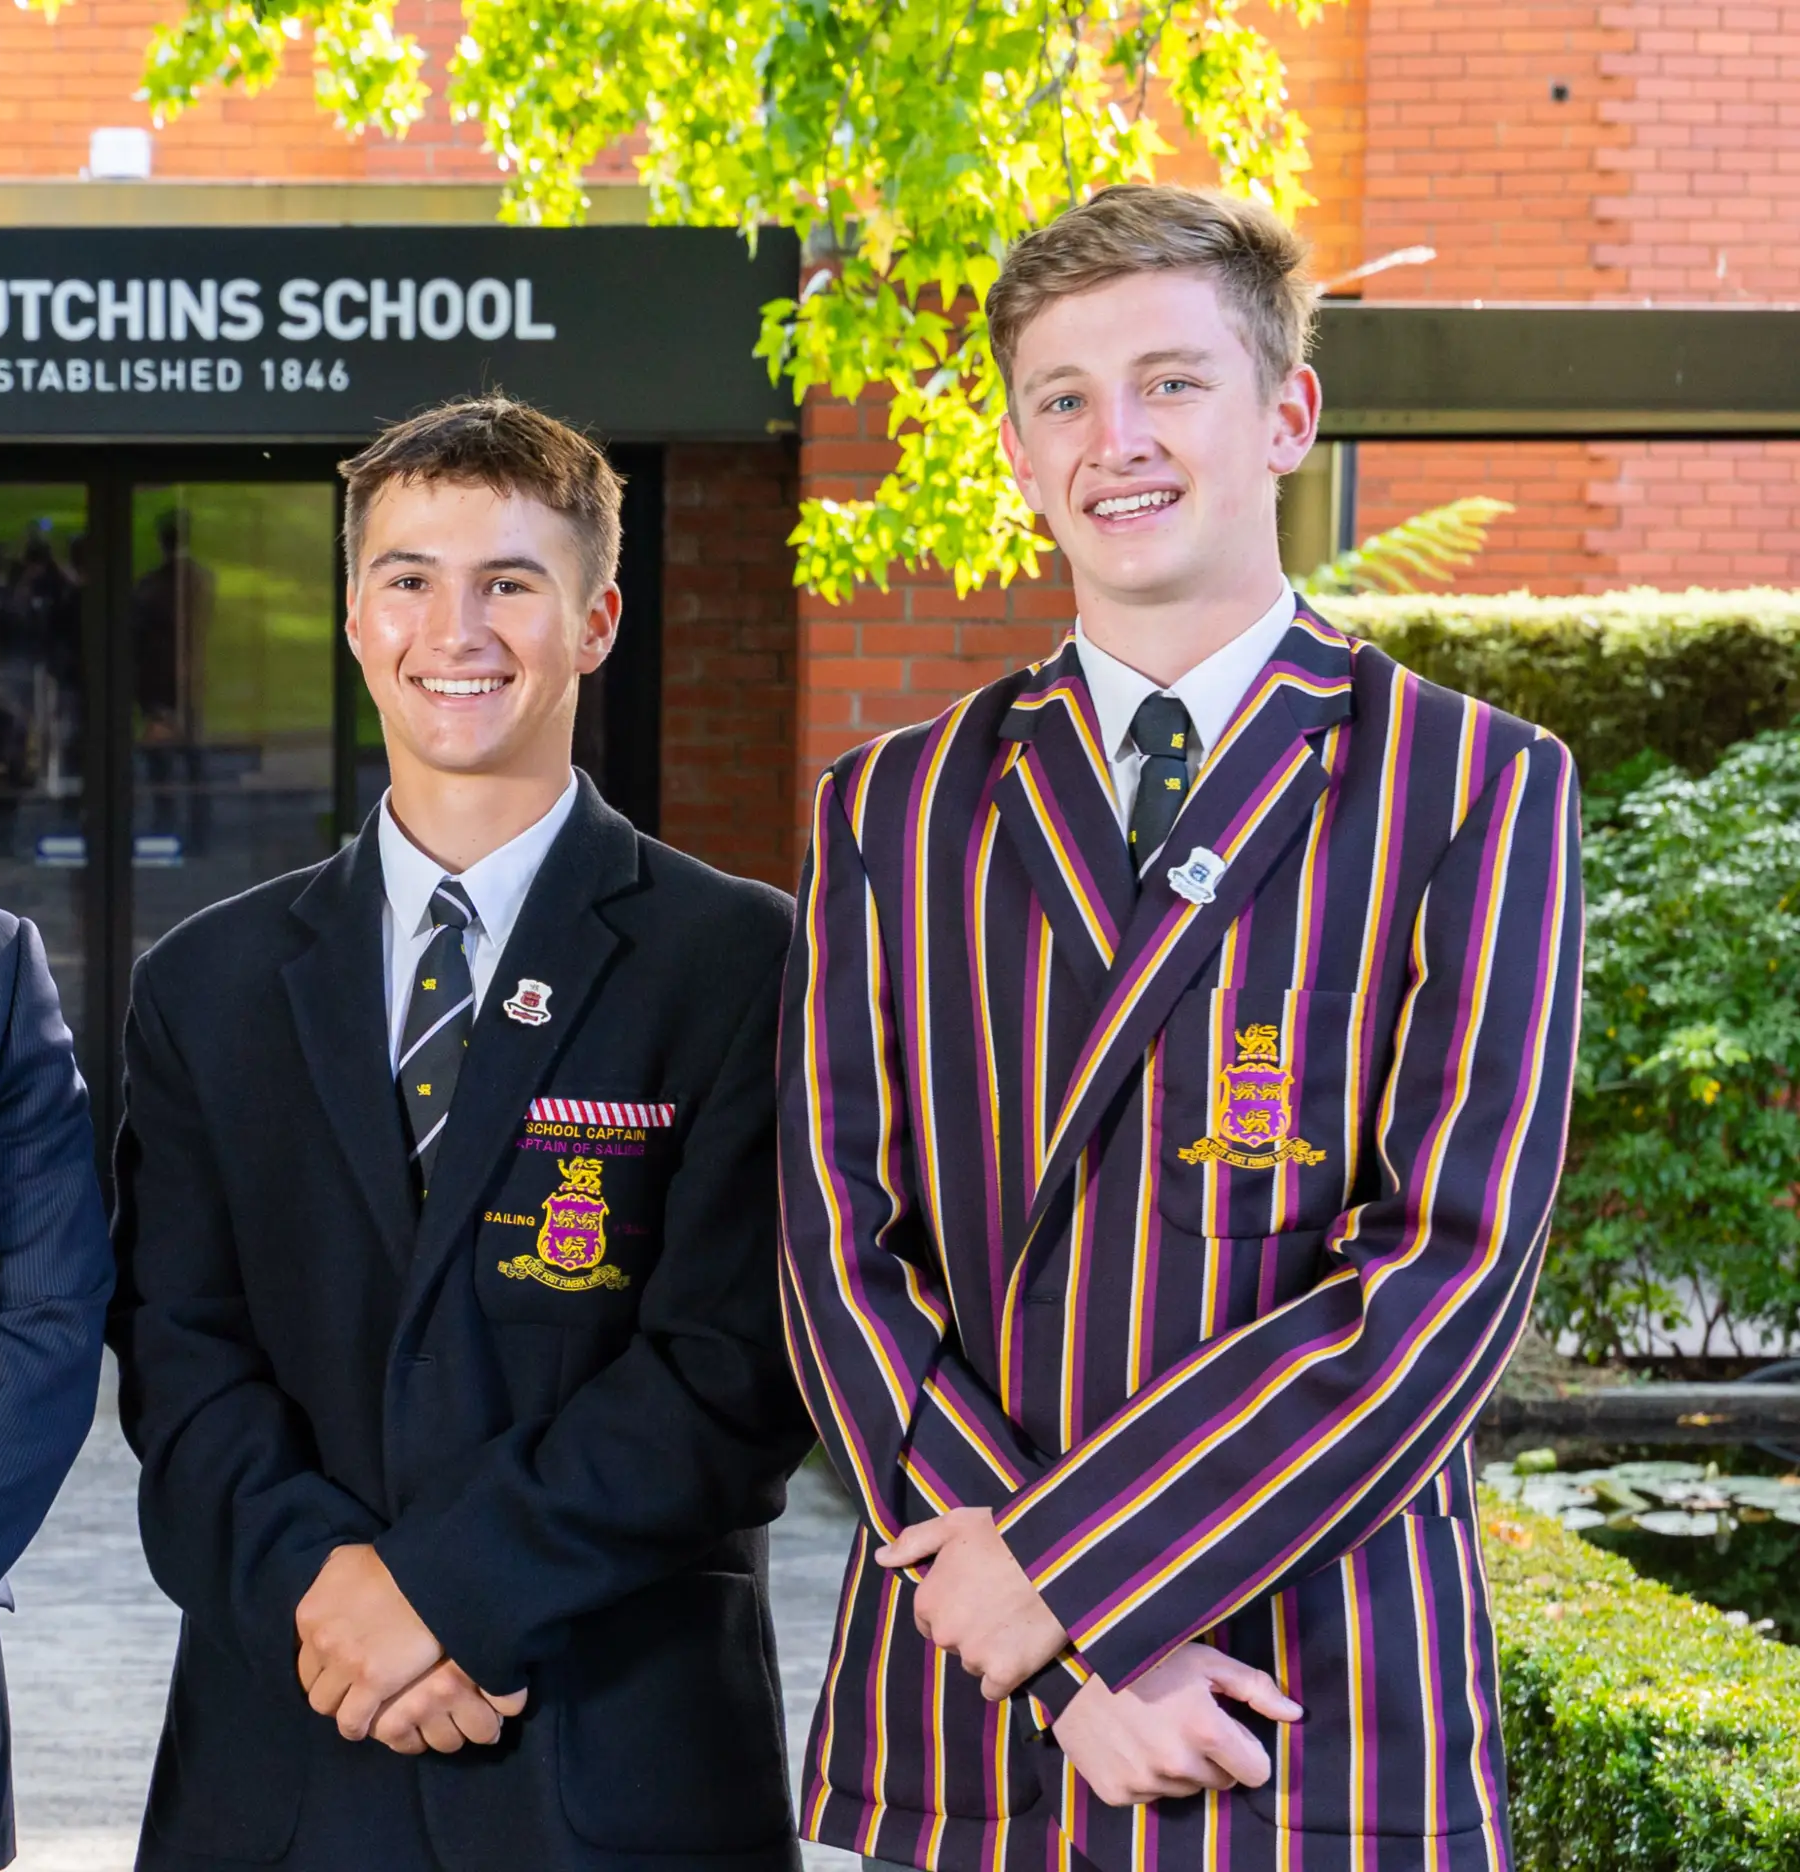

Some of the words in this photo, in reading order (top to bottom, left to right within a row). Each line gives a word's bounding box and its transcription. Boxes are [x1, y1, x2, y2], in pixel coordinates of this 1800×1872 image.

[277, 277, 557, 341] SCHOOL
[260, 358, 350, 393] 1846
[525, 1121, 582, 1138] SCHOOL
[586, 1126, 647, 1141] CAPTAIN
[514, 1137, 568, 1153] APTAIN
[572, 1142, 592, 1154] OF
[483, 1210, 536, 1227] SAILING
[540, 1271, 560, 1285] POST
[559, 1277, 588, 1288] FUNERA
